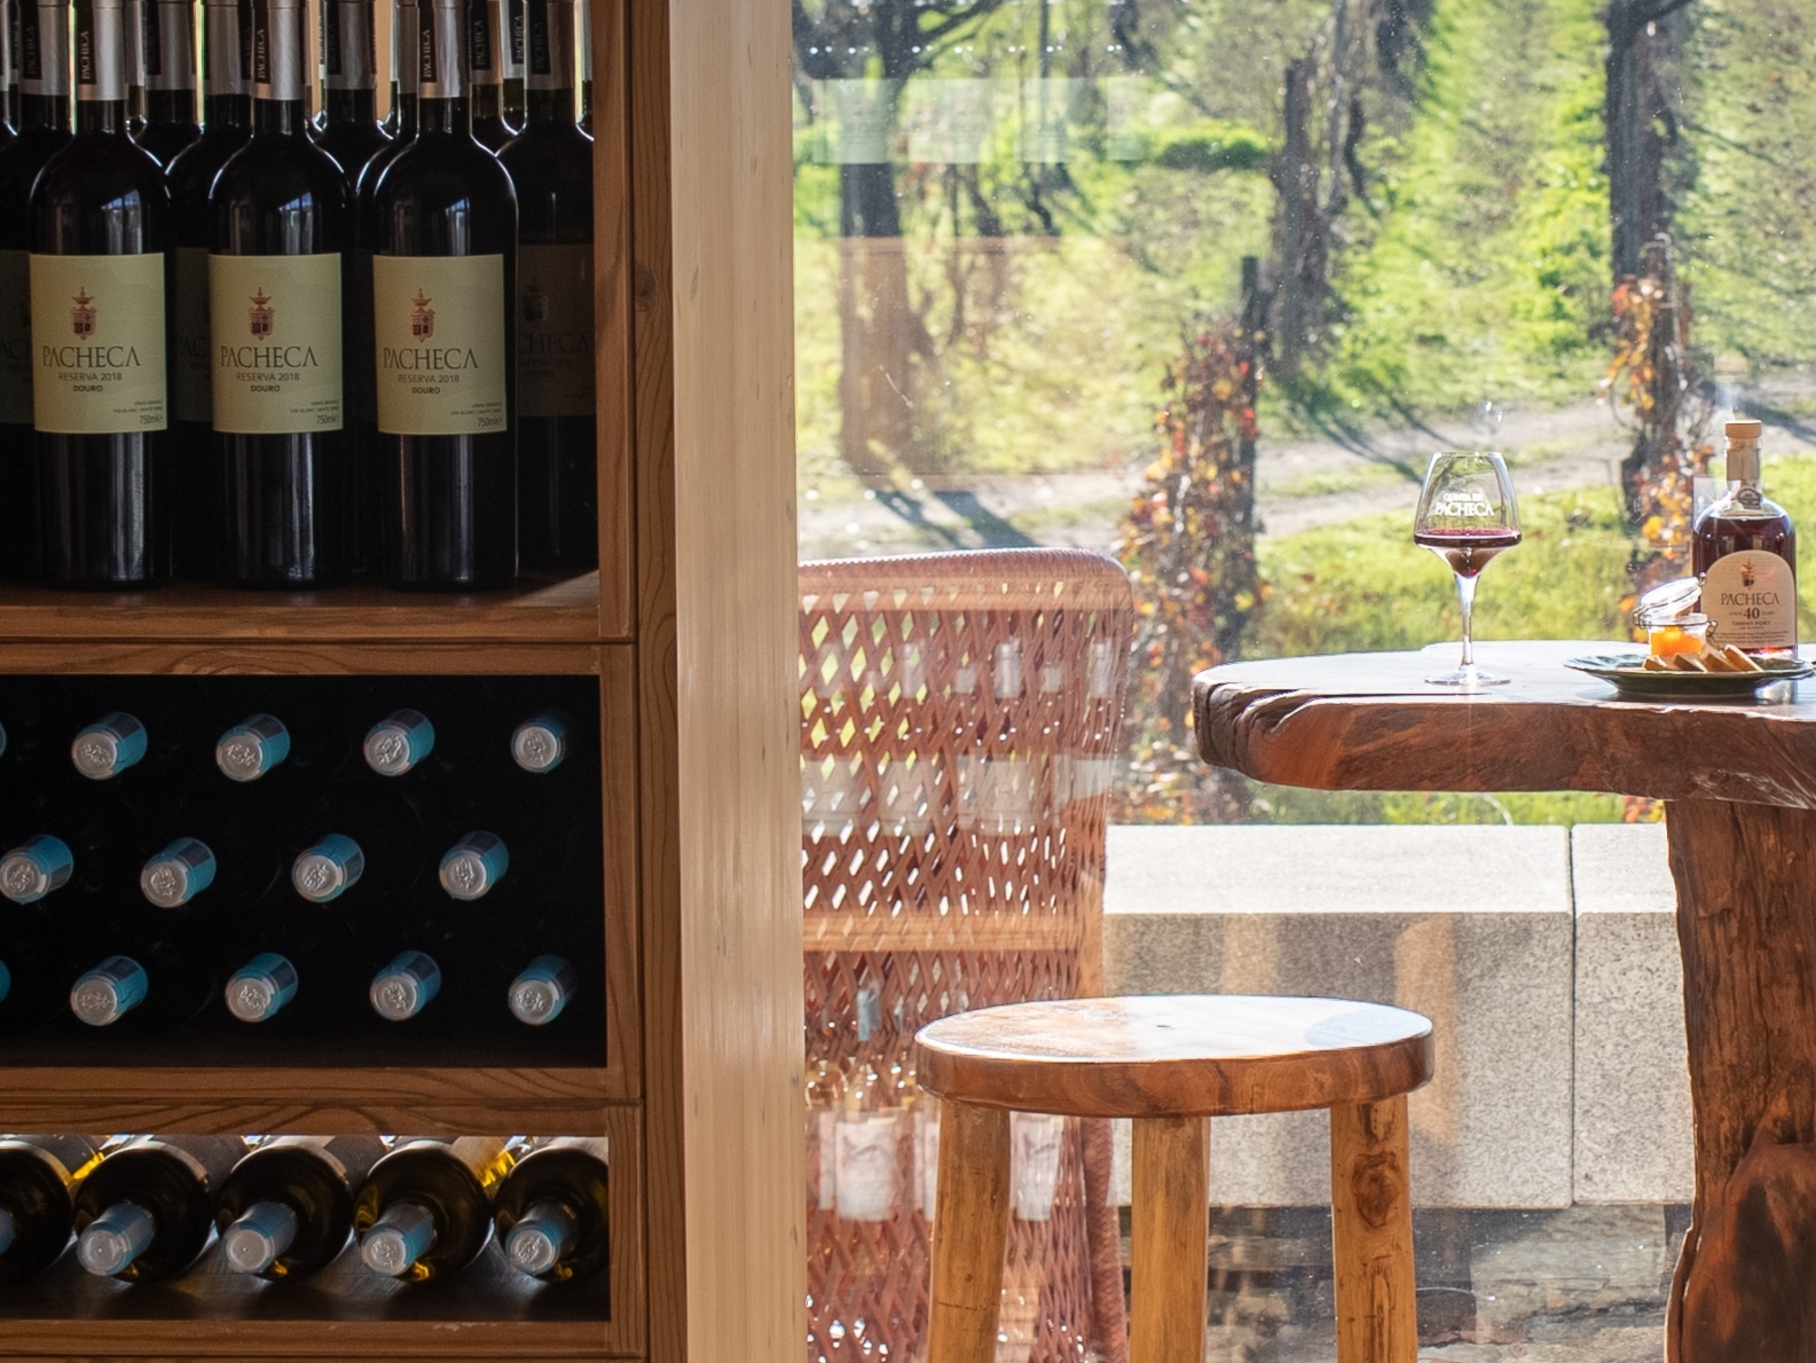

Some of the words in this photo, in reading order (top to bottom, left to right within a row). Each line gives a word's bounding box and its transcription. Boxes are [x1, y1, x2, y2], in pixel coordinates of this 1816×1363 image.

[42, 345, 142, 368] PACHECA
[220, 345, 318, 368] PACHECA
[382, 347, 479, 370] PACHECA
[58, 372, 98, 381] RESERVA
[100, 372, 122, 381] 2018
[236, 372, 276, 381] RESERVA
[278, 372, 300, 381] 2018
[398, 374, 436, 383] RESERVA
[438, 374, 460, 383] 2018
[1434, 501, 1495, 517] PACHECA
[1721, 592, 1780, 606] PACHECA
[1743, 607, 1760, 619] 40
